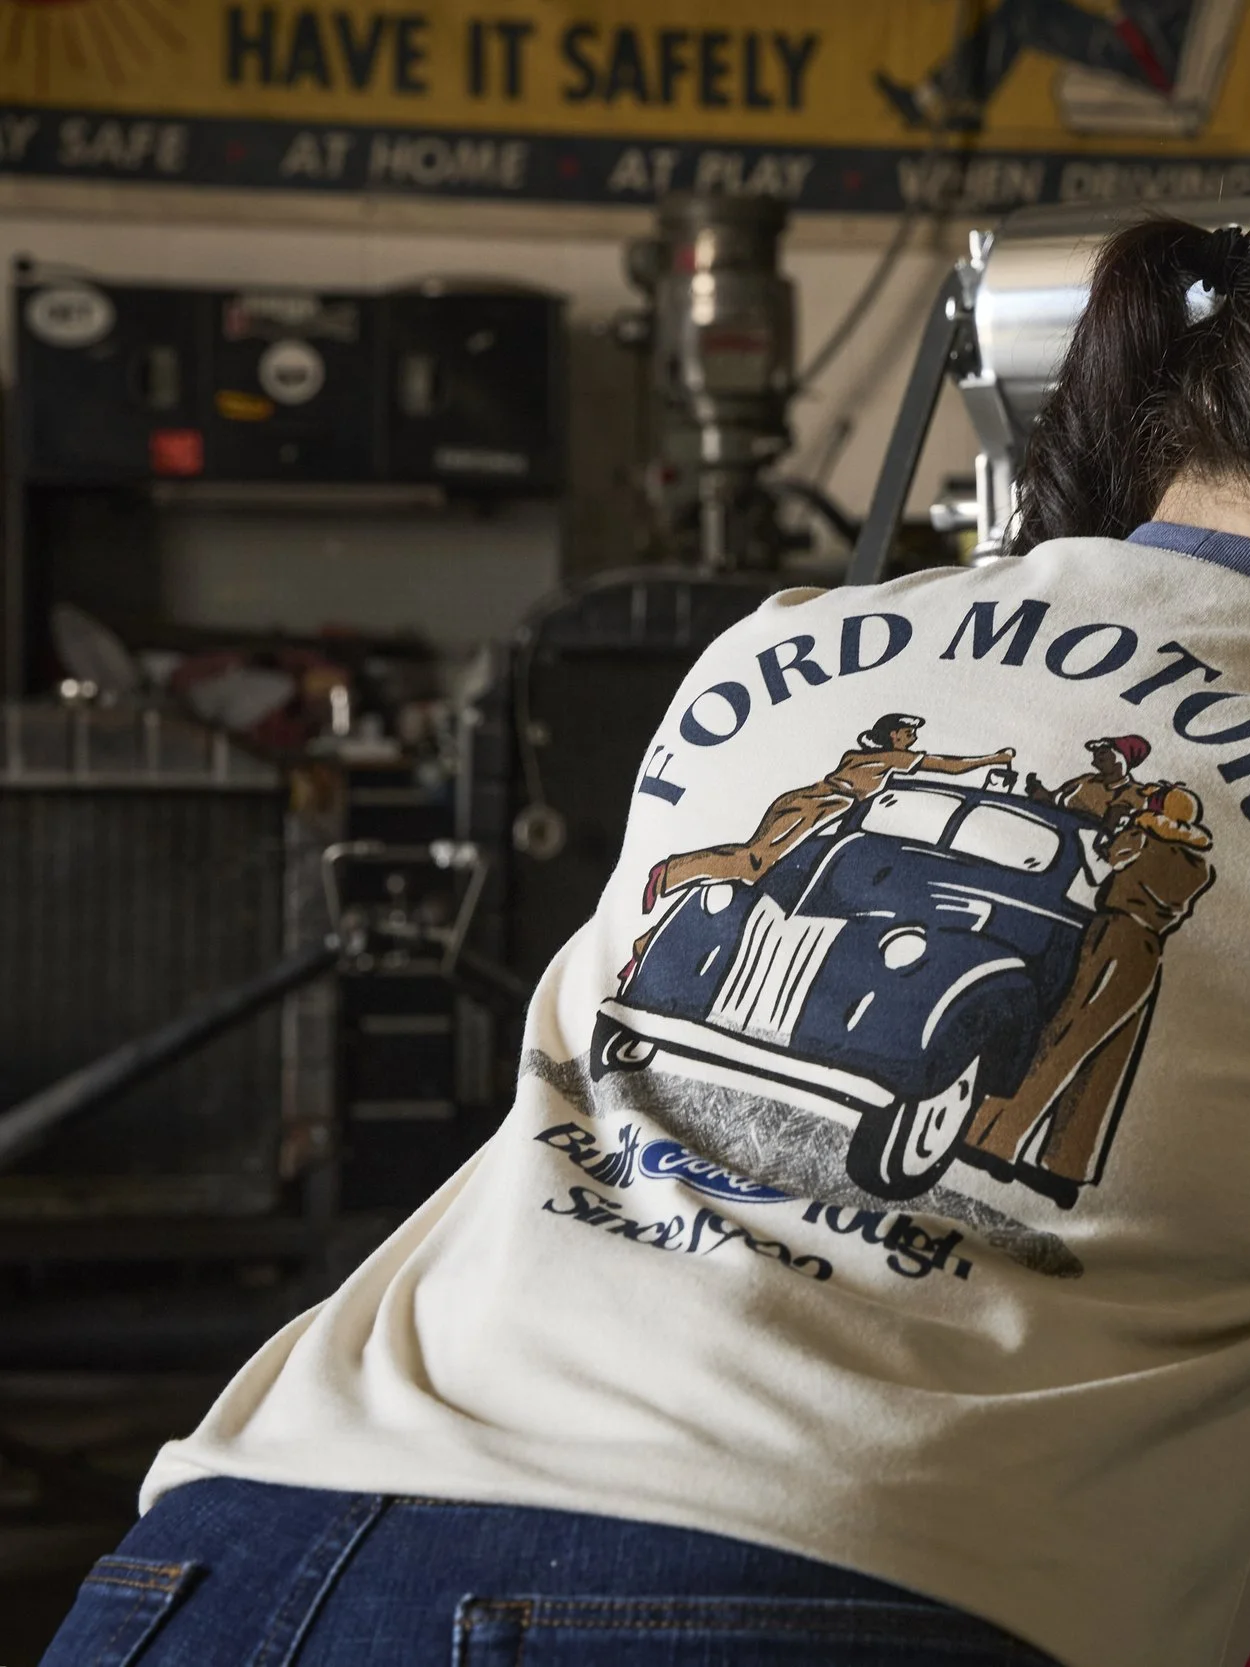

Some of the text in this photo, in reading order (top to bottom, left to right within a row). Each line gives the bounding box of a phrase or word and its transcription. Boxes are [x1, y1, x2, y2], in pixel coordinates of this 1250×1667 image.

[224, 5, 822, 113] HAVE IT SAFELY
[57, 117, 188, 174] SAFE
[280, 131, 353, 179] AT
[367, 134, 531, 189] HOME
[607, 146, 682, 197] AT
[692, 149, 817, 201] PLAY
[636, 612, 914, 807] FORD
[541, 1185, 686, 1252] Since
